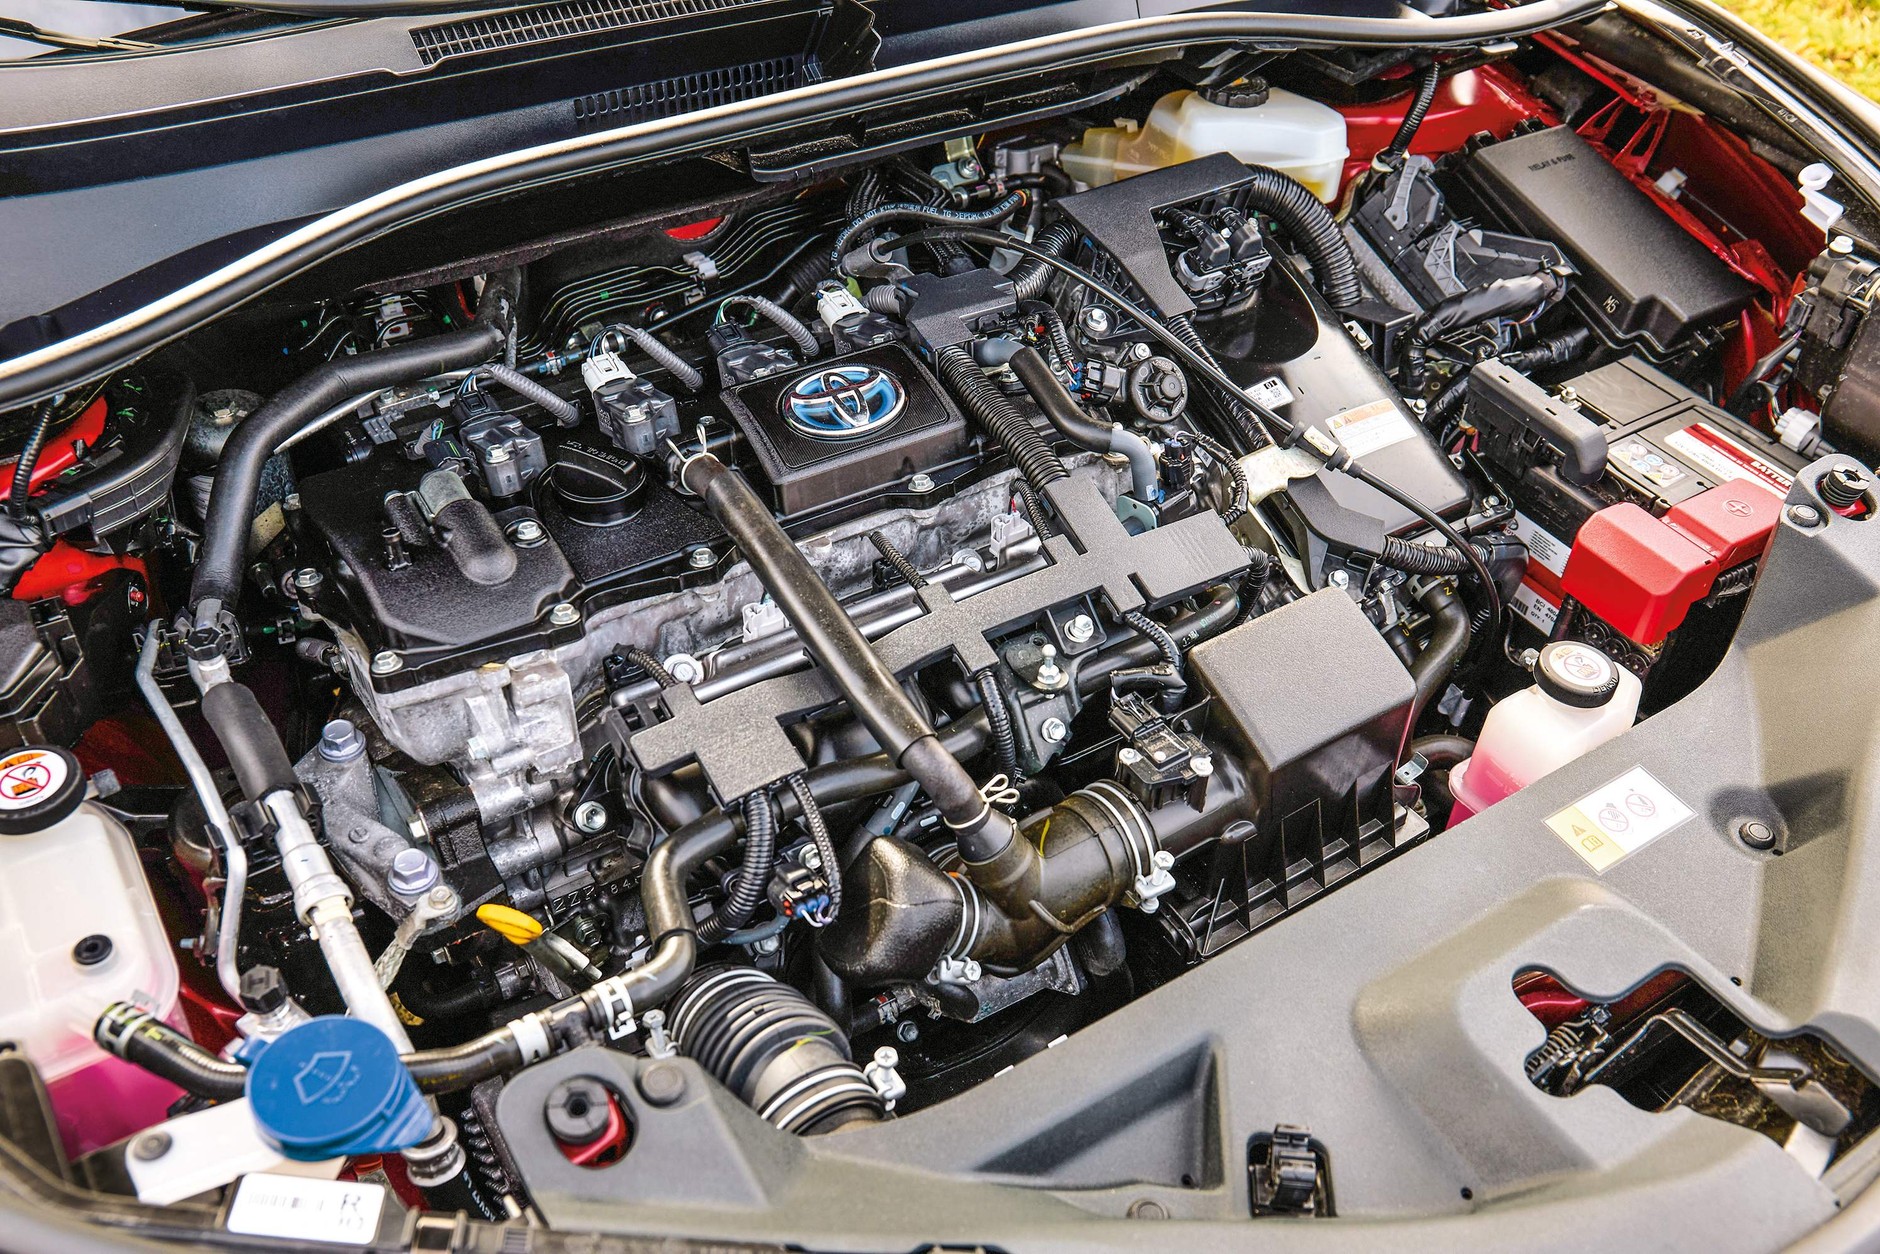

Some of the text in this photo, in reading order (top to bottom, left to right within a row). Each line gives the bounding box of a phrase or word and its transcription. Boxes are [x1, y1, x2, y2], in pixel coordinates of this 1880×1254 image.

[852, 217, 863, 228] DO
[863, 208, 877, 220] NOT
[922, 205, 939, 216] FUEL
[943, 209, 952, 218] TG
[1750, 460, 1793, 488] BATTER
